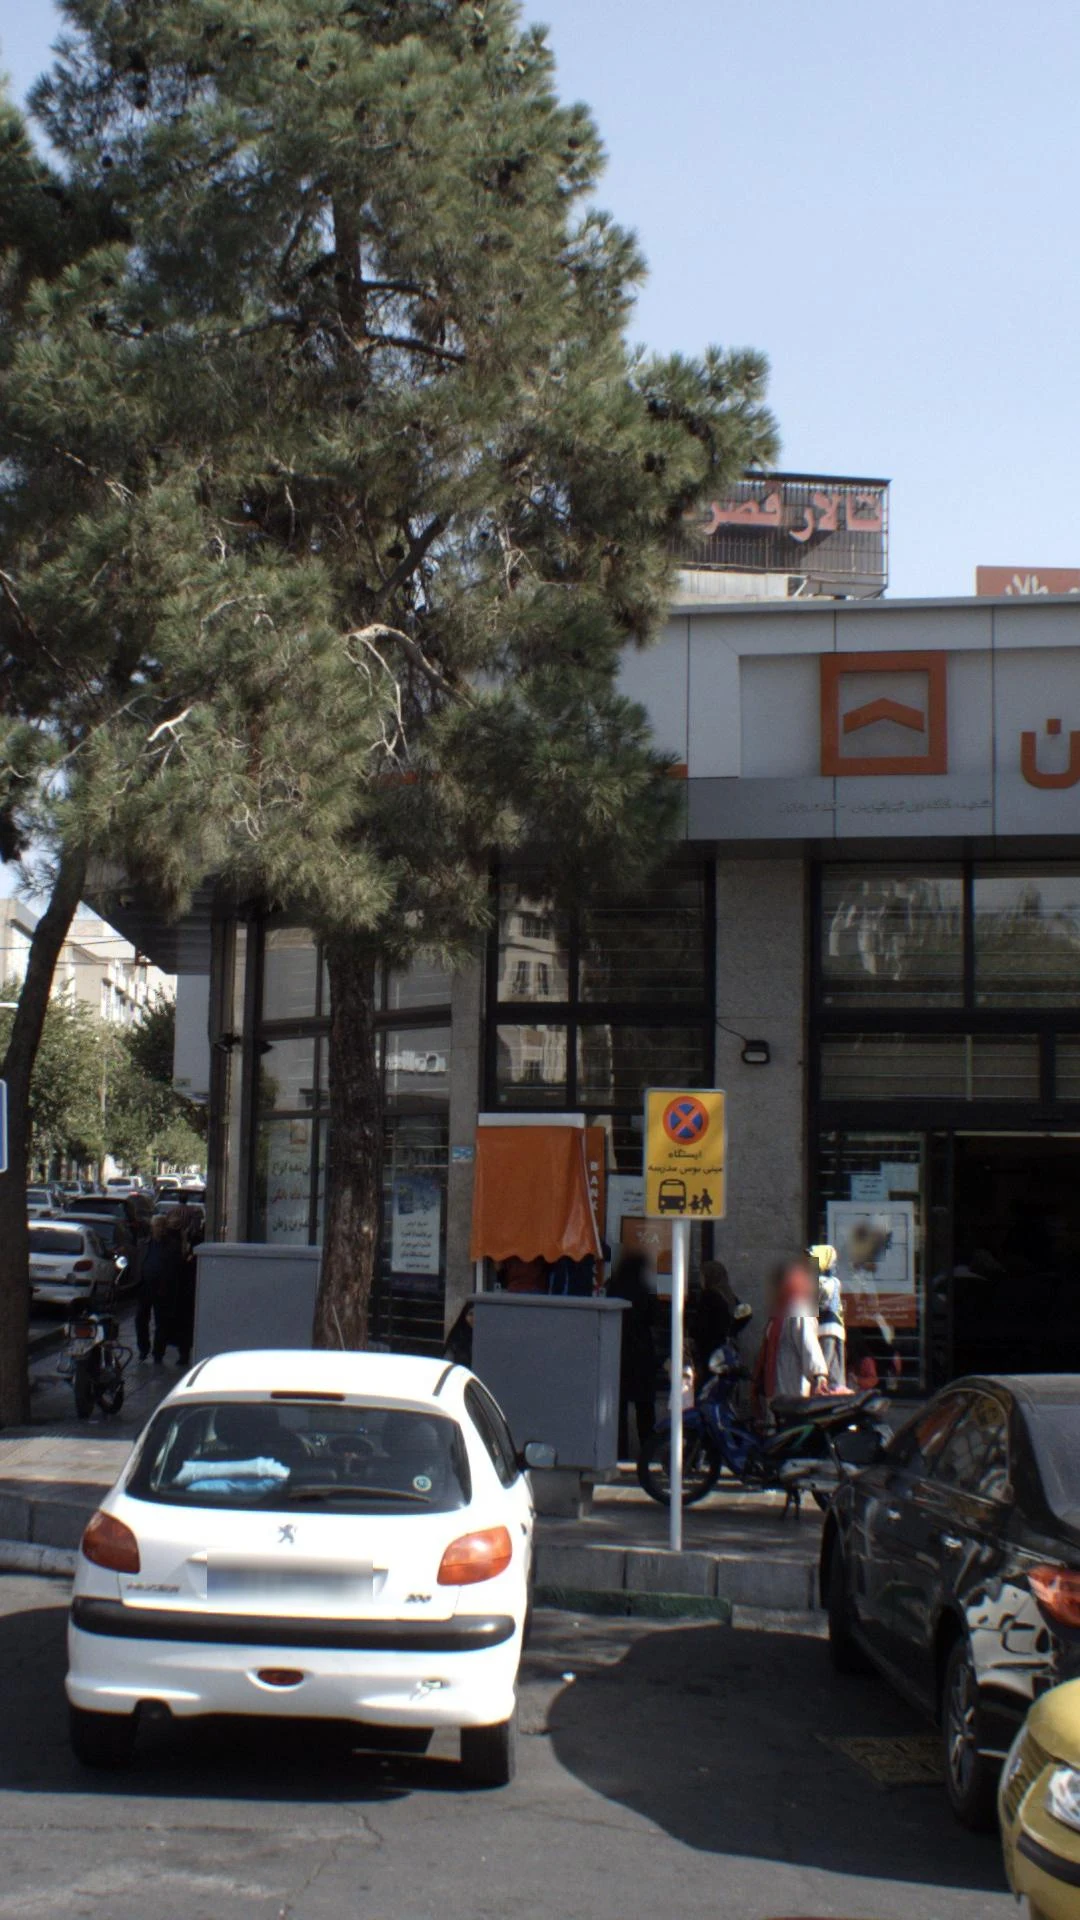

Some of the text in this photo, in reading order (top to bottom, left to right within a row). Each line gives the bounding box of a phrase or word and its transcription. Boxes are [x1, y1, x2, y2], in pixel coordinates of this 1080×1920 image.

[789, 491, 883, 542] تالار
[668, 1149, 702, 1160] ایستگاه
[647, 1165, 723, 1175] مینی بوس مدرسه
[590, 1161, 599, 1211] BANK
